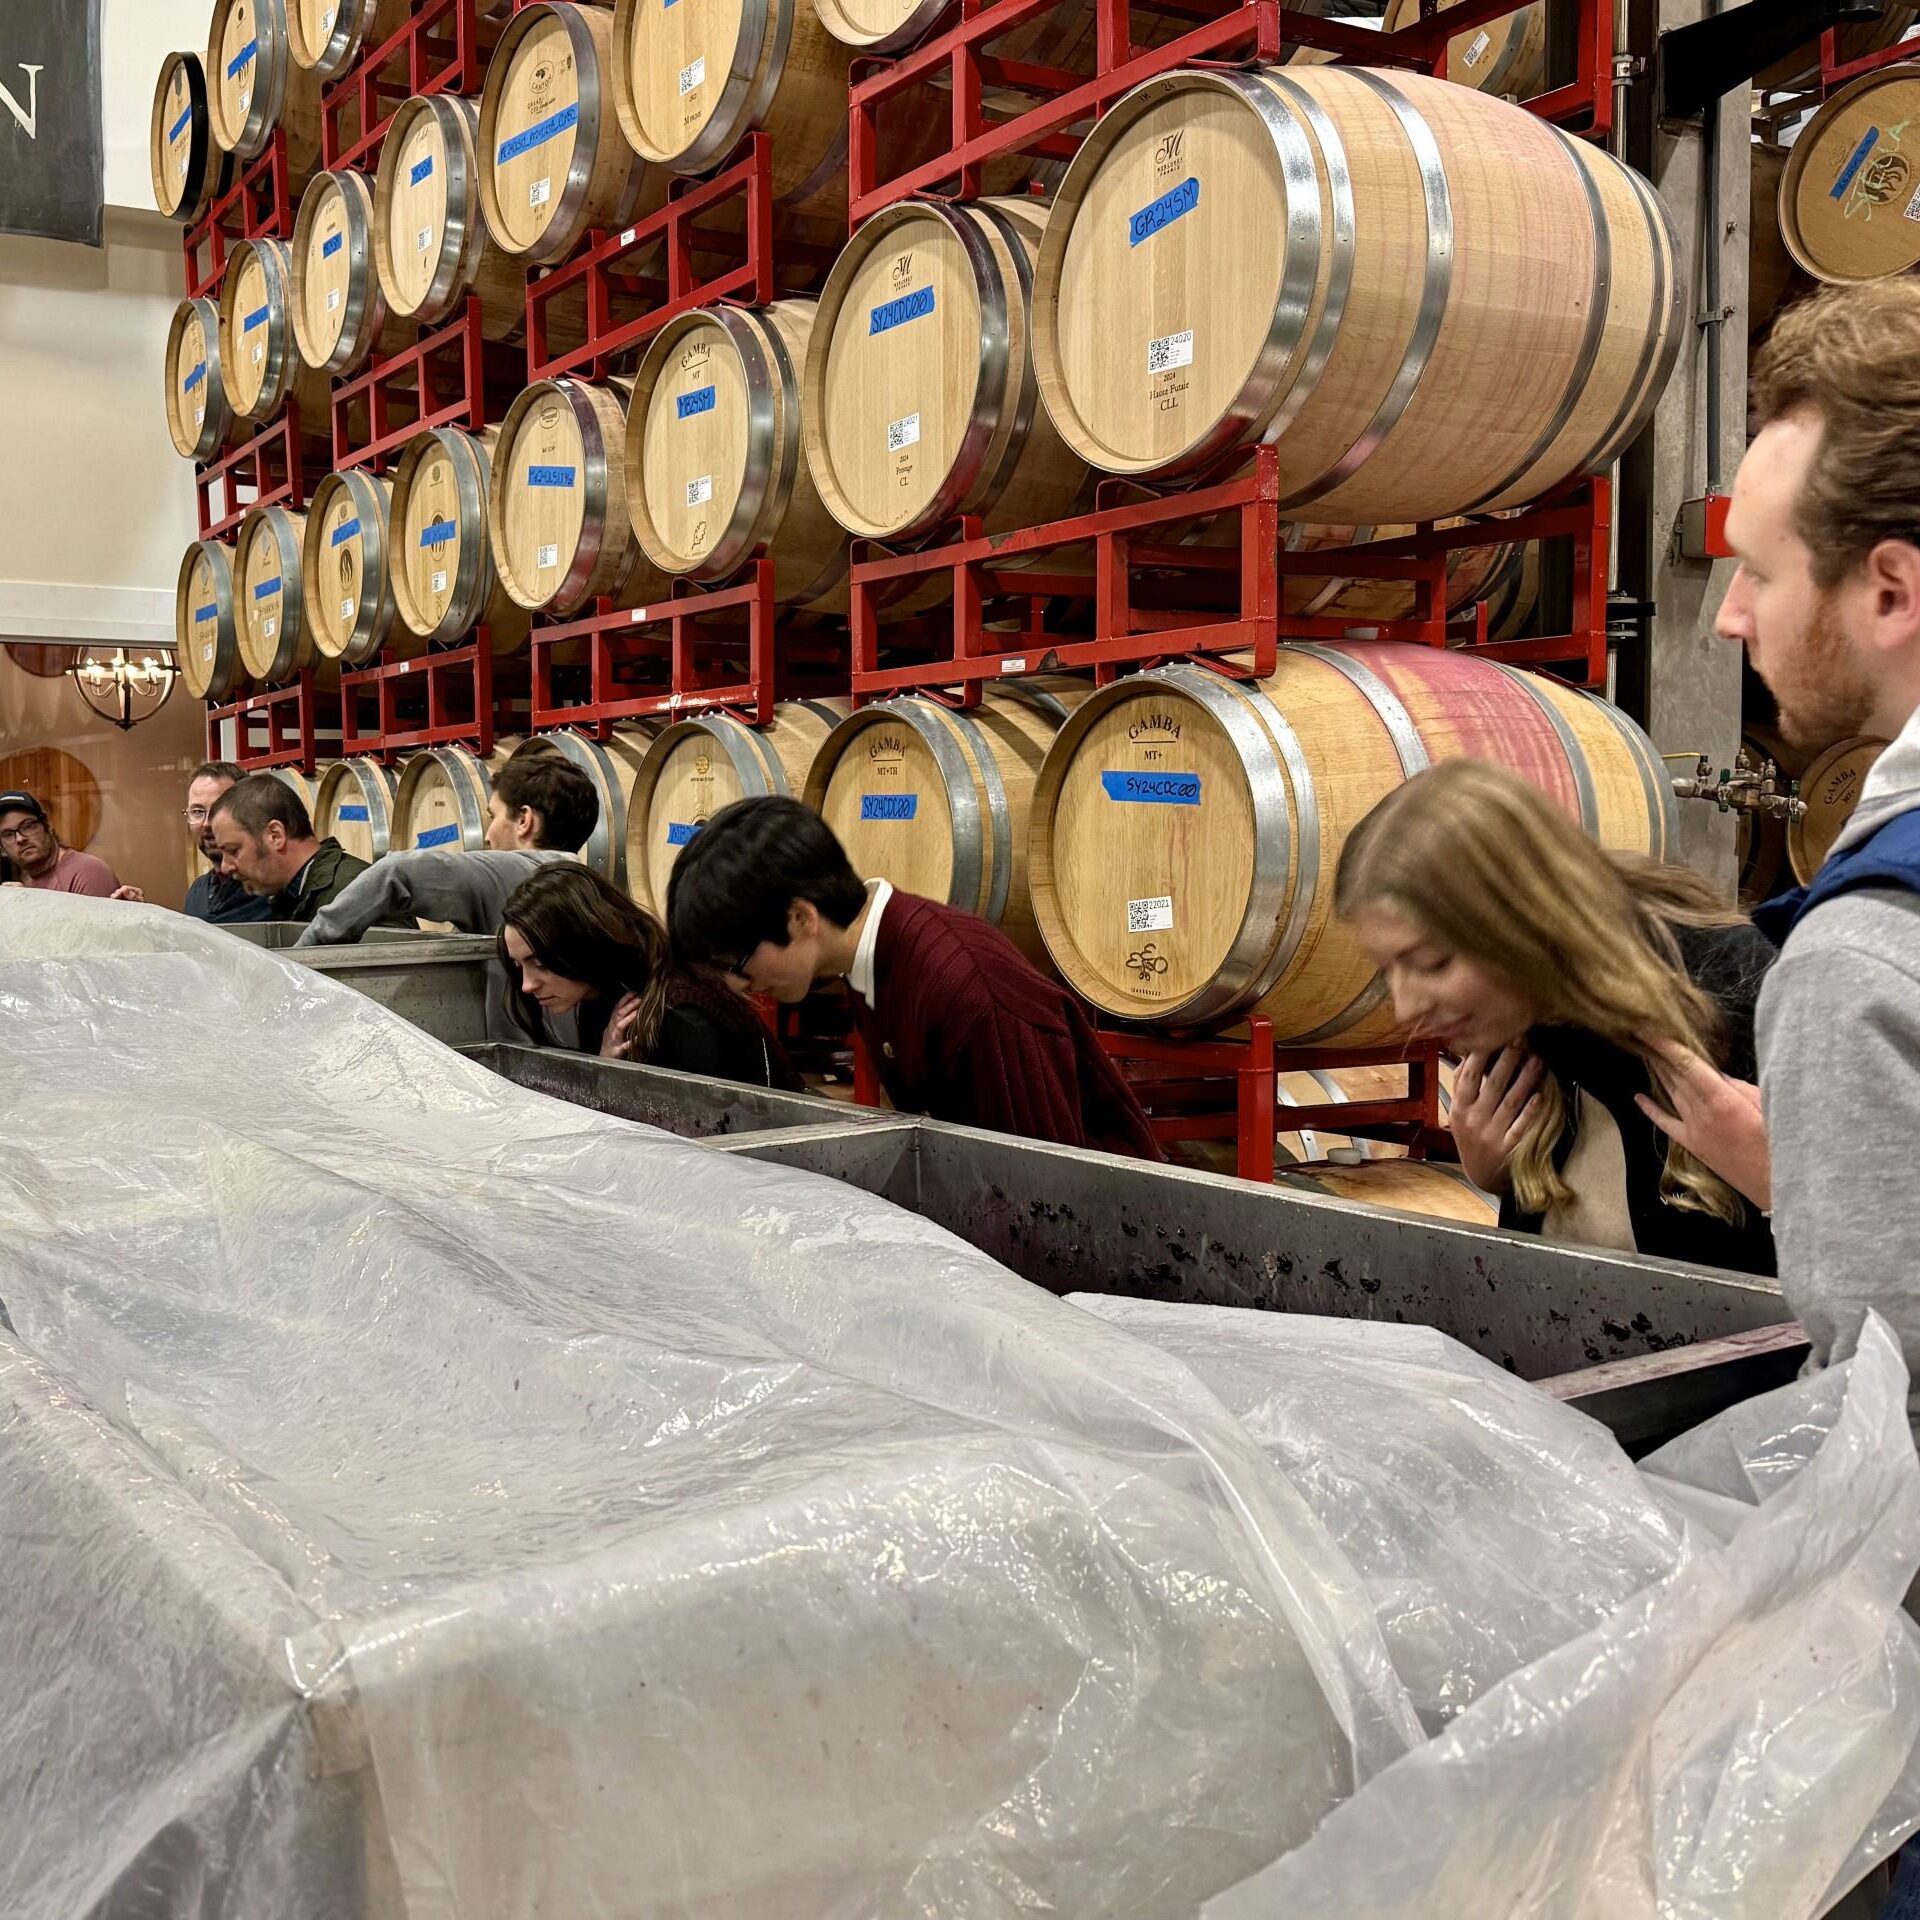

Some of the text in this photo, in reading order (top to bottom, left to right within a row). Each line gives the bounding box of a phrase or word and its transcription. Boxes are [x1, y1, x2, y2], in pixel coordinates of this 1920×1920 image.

[1135, 183, 1194, 236] GR24SM
[1170, 332, 1192, 346] 24020
[681, 343, 711, 368] GAMBA
[1128, 714, 1181, 740] GAMBA
[870, 737, 906, 758] GAMBA
[1144, 750, 1163, 760] MT+
[1824, 768, 1856, 805] GAMBA
[1148, 899, 1170, 910] 22021
